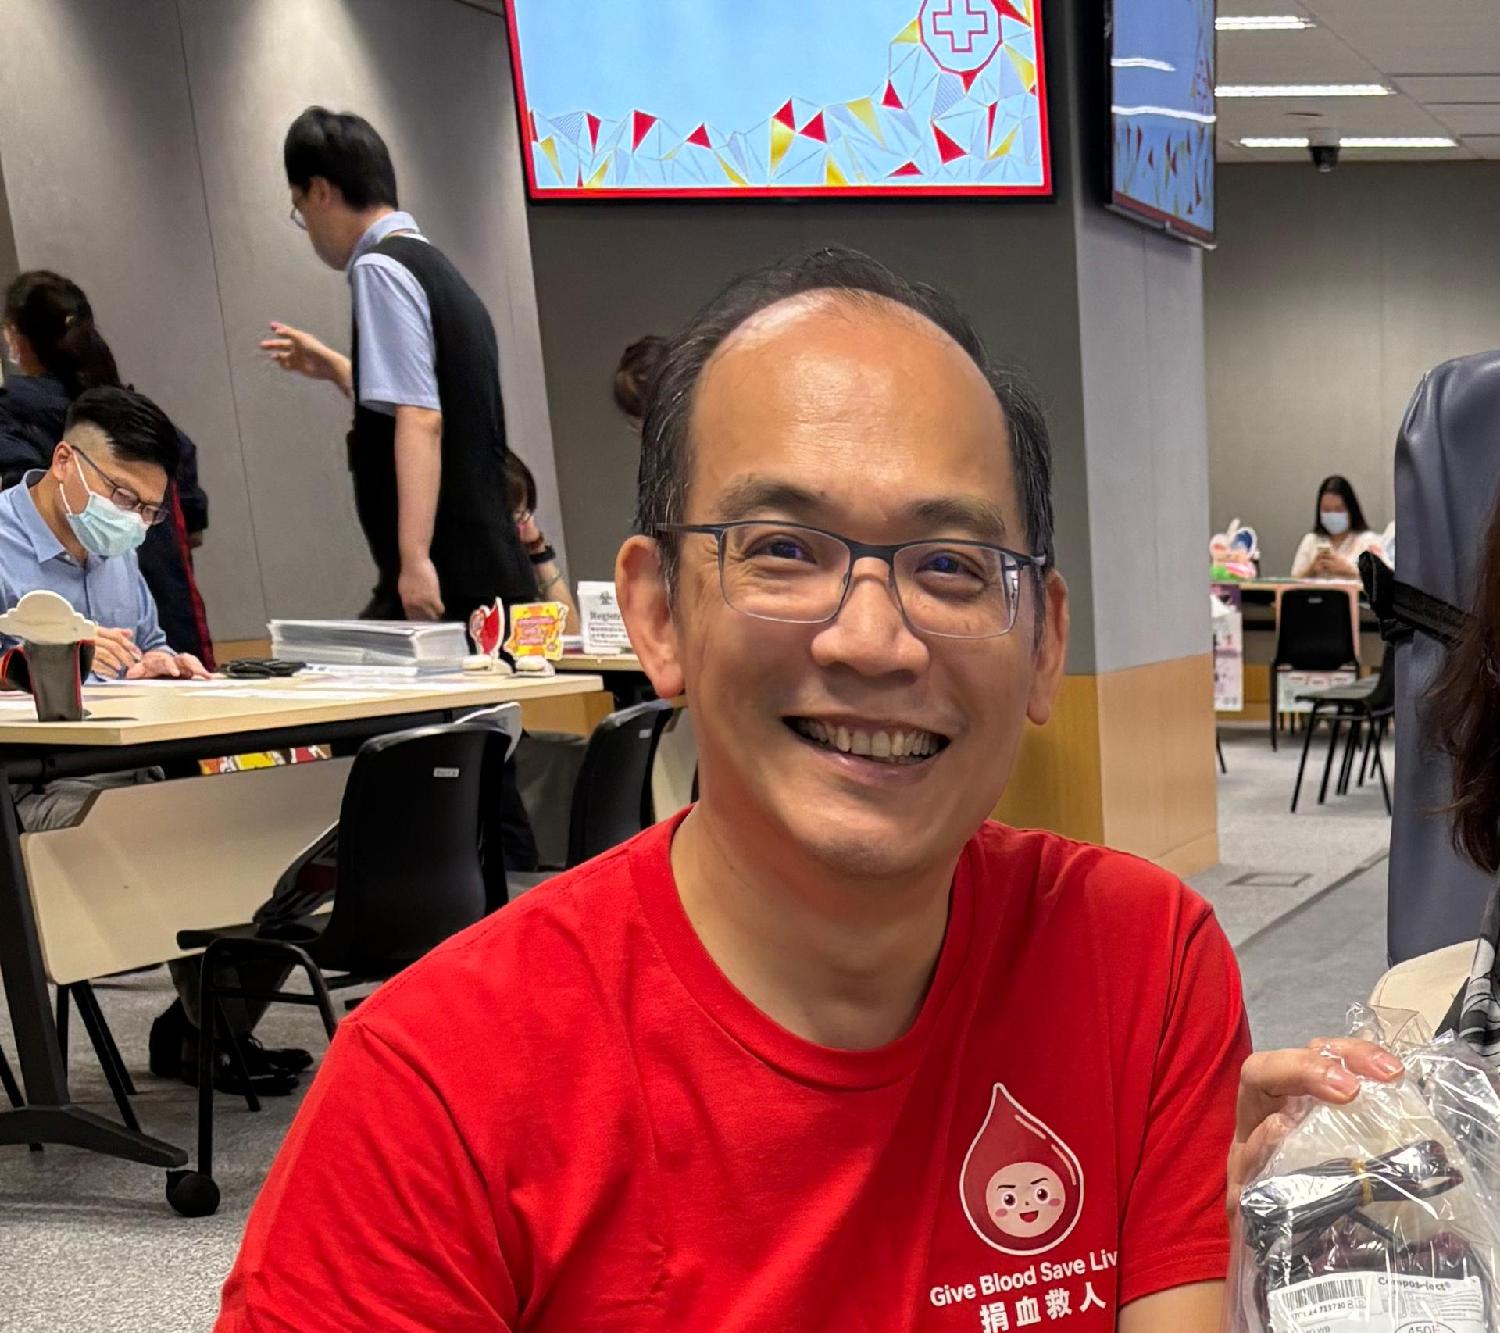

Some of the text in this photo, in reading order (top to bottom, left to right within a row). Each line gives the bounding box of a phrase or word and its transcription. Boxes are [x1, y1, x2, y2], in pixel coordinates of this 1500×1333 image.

[930, 1281, 977, 1306] Give
[979, 1265, 1037, 1296] Blood
[1040, 1258, 1086, 1282] Save
